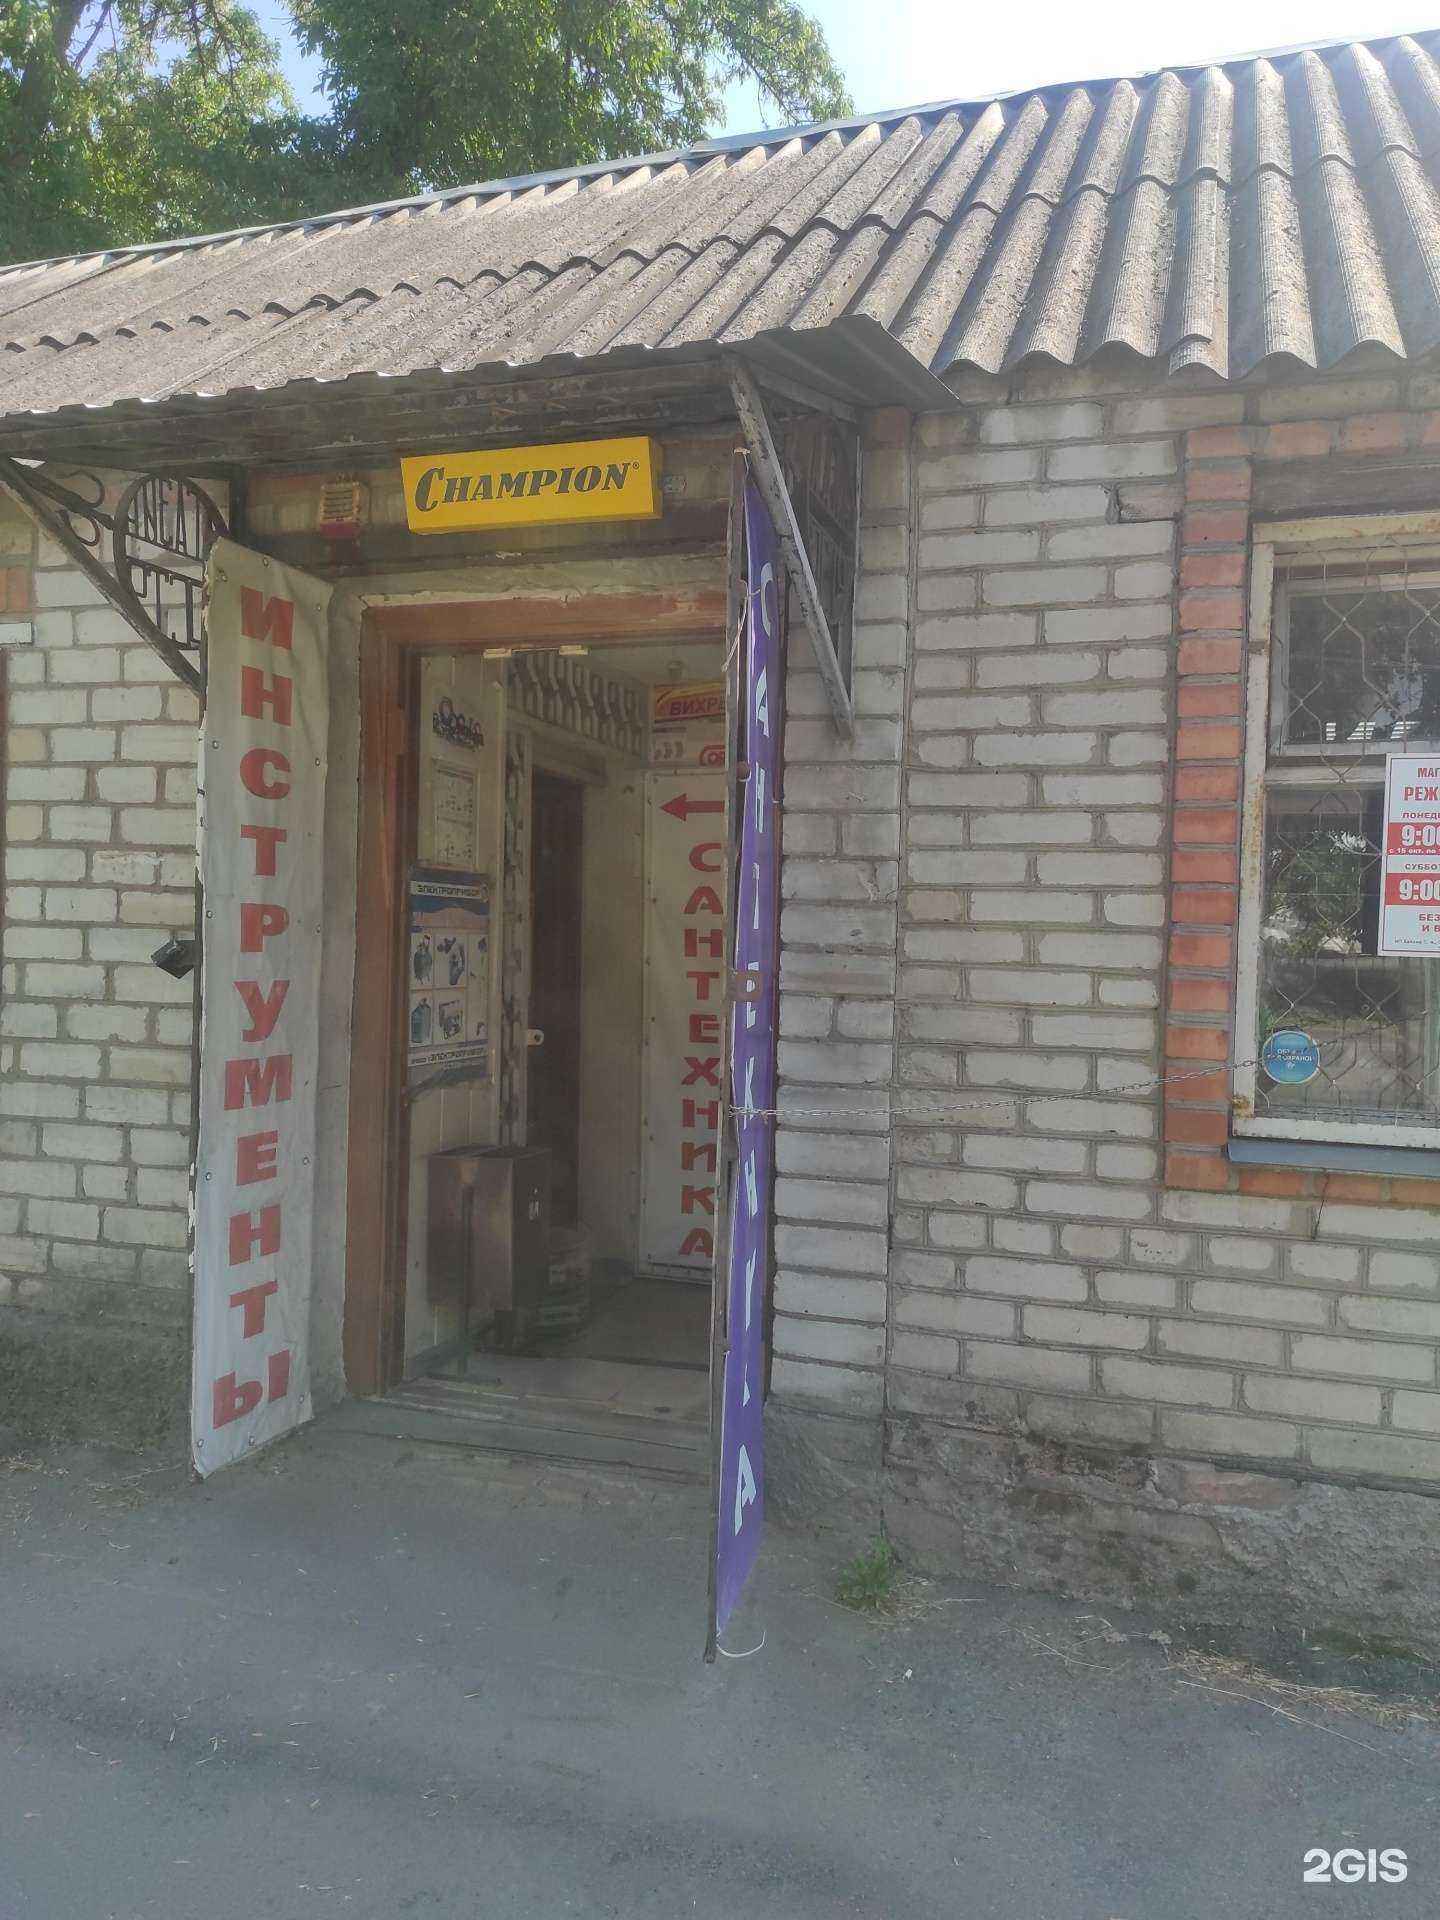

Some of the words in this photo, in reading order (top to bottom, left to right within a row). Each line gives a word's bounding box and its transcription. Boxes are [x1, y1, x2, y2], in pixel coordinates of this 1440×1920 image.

[414, 462, 631, 512] CHAMPION
[1402, 825, 1440, 847] 9:0
[213, 585, 295, 1430] ИНСТРУМЕНТЫ
[678, 842, 724, 1258] САНТЕХНИКА
